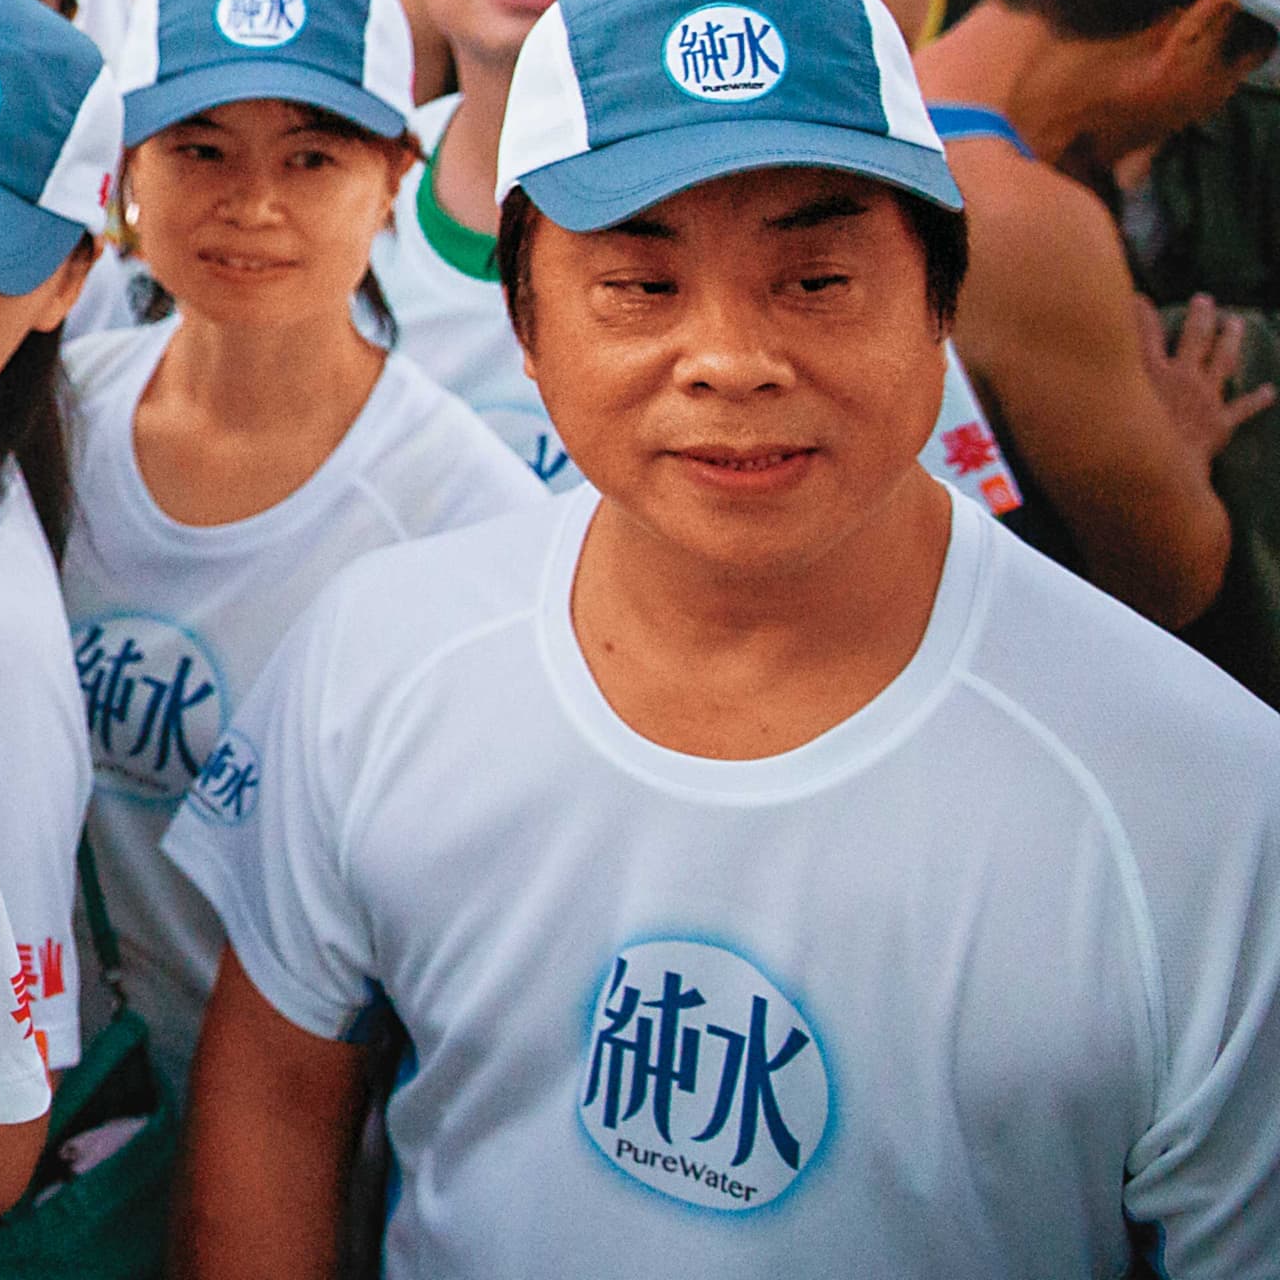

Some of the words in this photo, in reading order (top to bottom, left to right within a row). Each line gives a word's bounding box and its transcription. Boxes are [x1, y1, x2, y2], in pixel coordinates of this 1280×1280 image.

[679, 17, 780, 84] 純水
[583, 957, 811, 1171] 純水
[615, 1138, 759, 1203] PureWater
